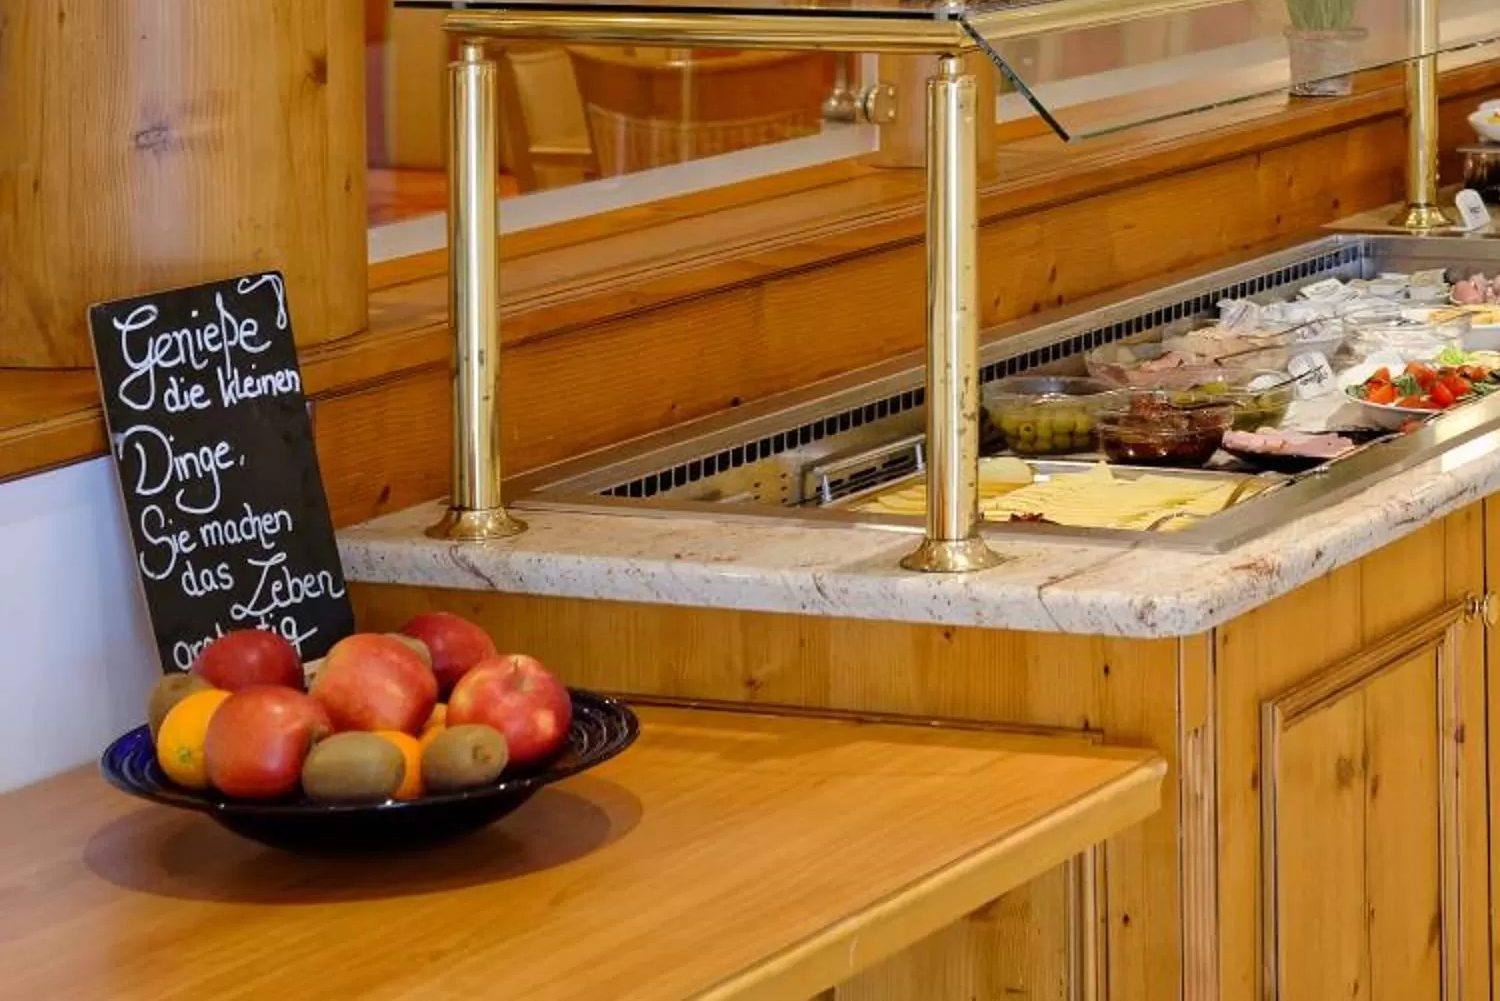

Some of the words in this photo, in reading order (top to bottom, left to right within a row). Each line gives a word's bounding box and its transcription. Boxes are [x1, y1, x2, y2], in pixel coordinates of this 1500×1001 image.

[163, 376, 211, 412] die
[219, 365, 301, 407] kleinen
[139, 504, 197, 580] Sie
[200, 502, 293, 550] machen
[181, 559, 235, 597] das
[230, 552, 346, 618] Leben
